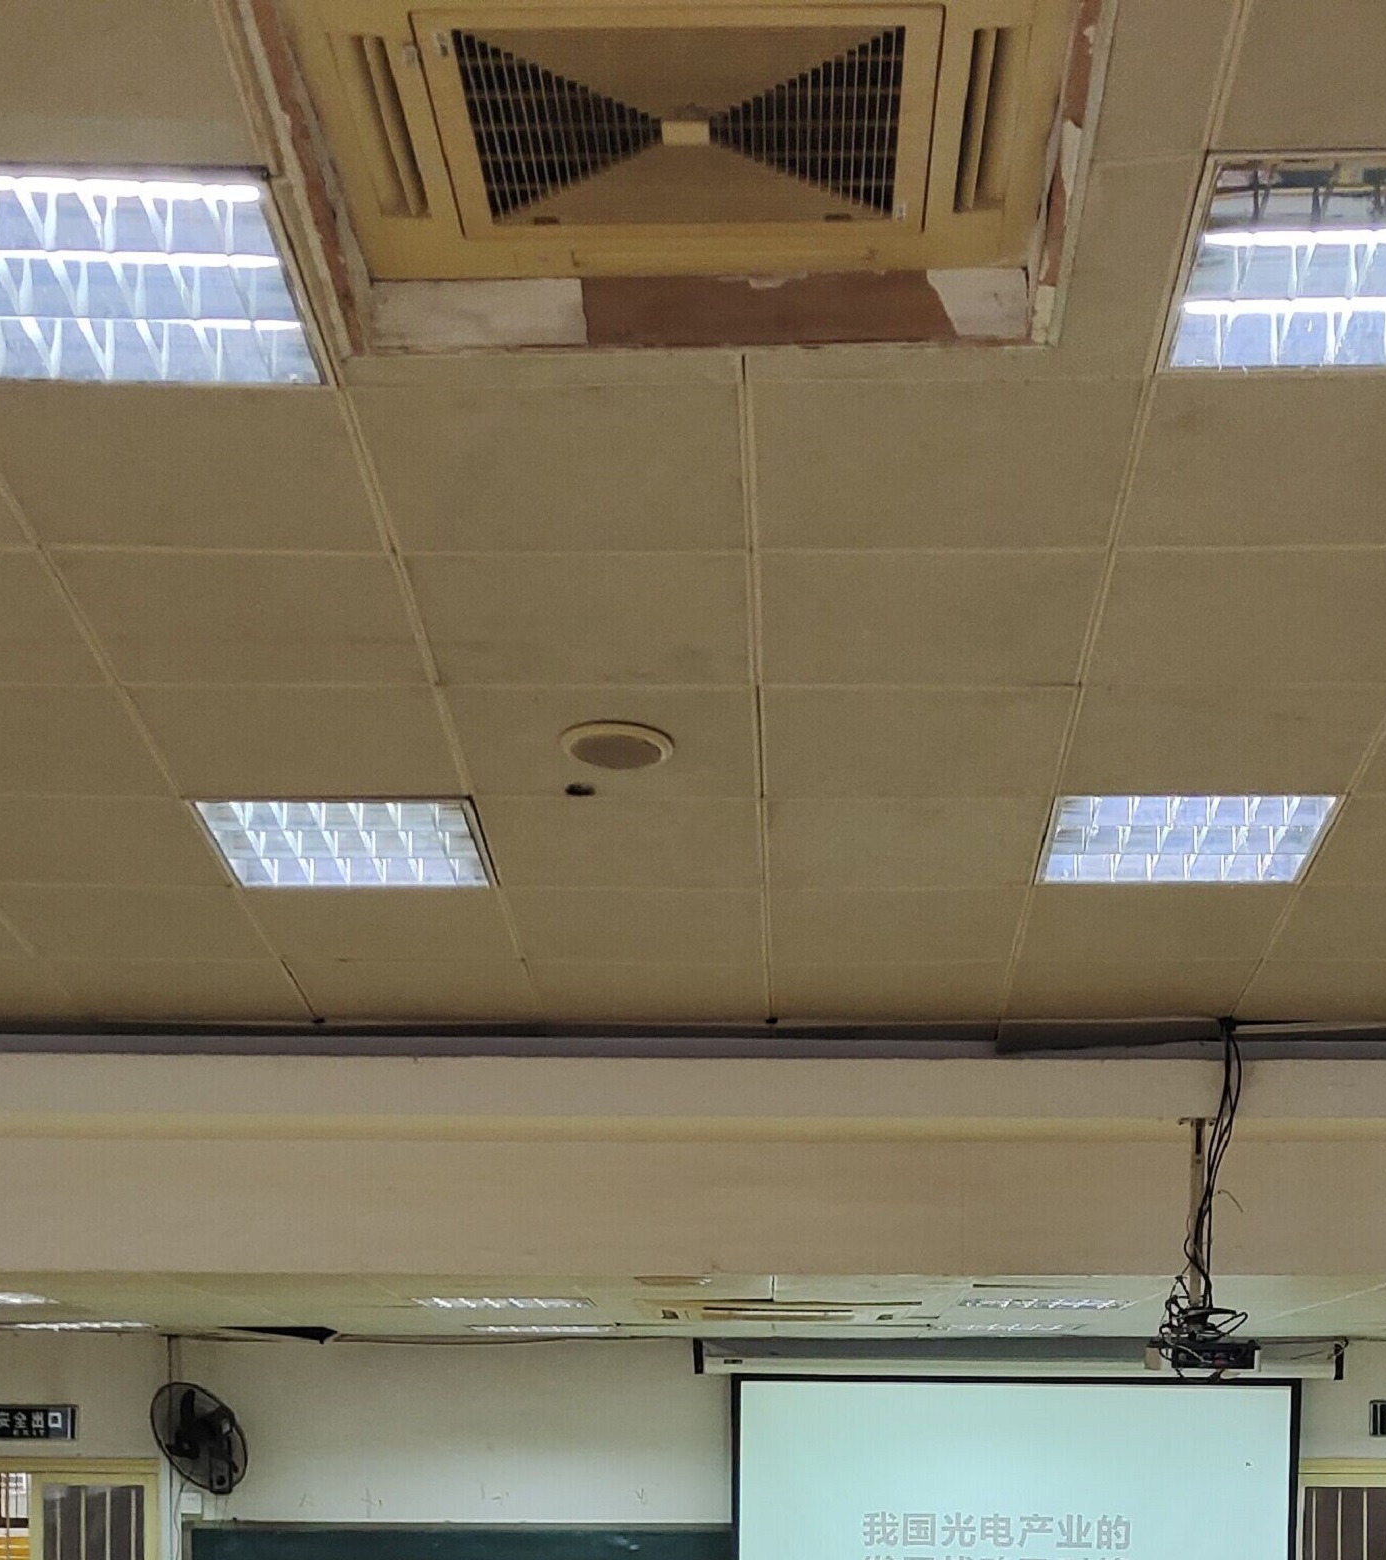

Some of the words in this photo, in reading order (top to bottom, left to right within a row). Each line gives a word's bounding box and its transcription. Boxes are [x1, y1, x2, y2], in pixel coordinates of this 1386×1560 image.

[12, 1429, 46, 1437] EXIT
[862, 1512, 1131, 1550] 我国光电产业的
